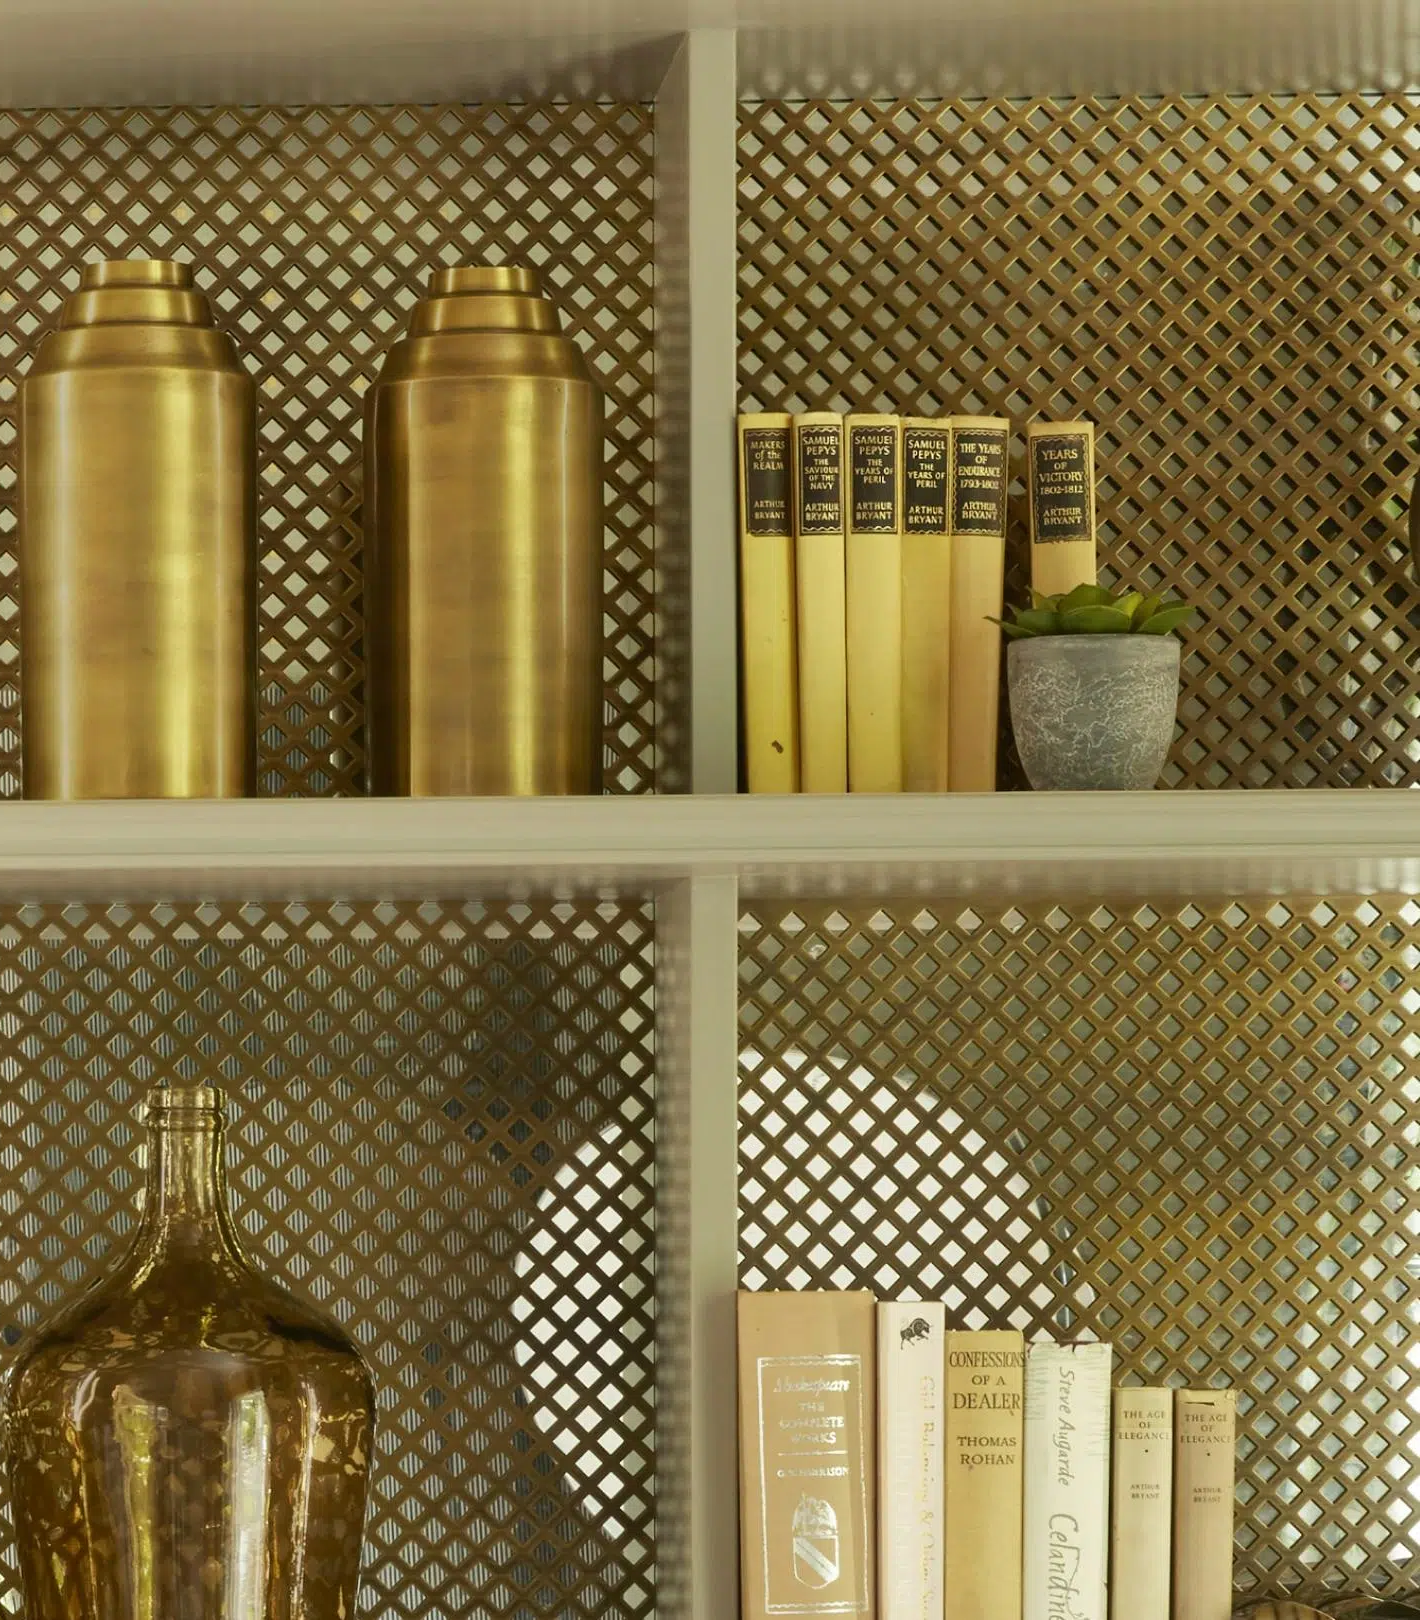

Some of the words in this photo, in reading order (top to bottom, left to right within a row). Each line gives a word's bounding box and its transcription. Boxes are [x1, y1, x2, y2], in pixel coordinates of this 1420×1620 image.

[750, 441, 785, 449] MAKERS
[803, 436, 839, 445] SAMUEL
[854, 436, 893, 445] SAMUEL
[908, 439, 946, 450] SAMUEL
[806, 446, 836, 456] PEPYS
[860, 446, 890, 455] PEPYS
[960, 444, 977, 454] THE
[978, 443, 1001, 454] YEARS
[755, 451, 763, 461] of
[768, 451, 781, 459] the
[912, 450, 941, 460] PEPYS
[1042, 449, 1078, 460] YEARS
[975, 455, 988, 464] OF
[753, 462, 784, 470] REALM
[805, 466, 839, 474] SAVIOUR
[919, 463, 934, 471] THE
[1054, 462, 1067, 470] OF
[855, 467, 881, 475] YEARS
[883, 467, 893, 475] OF
[908, 471, 933, 479] YEARS
[935, 471, 946, 479] OF
[958, 466, 1000, 477] ENDURANCE
[863, 476, 886, 484] PERIL
[1039, 471, 1083, 483] VICTORY
[916, 480, 937, 488] PERIL
[1040, 485, 1083, 495] 1802-1812
[805, 503, 839, 511] ARTHUR
[857, 502, 893, 510] ARTHUR
[909, 506, 944, 515] ARTHUR
[963, 501, 998, 511] ARTHUR
[805, 512, 839, 520] BRYANT
[856, 511, 892, 520] BRYANT
[962, 510, 997, 520] BRYANT
[1043, 507, 1082, 517] ARTHUR
[909, 515, 943, 524] BRYANT
[1044, 516, 1082, 525] BRYANT
[949, 1351, 1026, 1368] CONFESSIONS
[971, 1375, 990, 1385] OF
[996, 1375, 1007, 1385] A
[1059, 1366, 1075, 1414] Steve
[953, 1392, 1021, 1409] DEALER
[1123, 1410, 1143, 1419] THE
[1147, 1410, 1165, 1419] AGE
[1184, 1414, 1205, 1422] THE
[1209, 1414, 1227, 1422] AGE
[1139, 1421, 1151, 1429] OF
[1119, 1432, 1169, 1440] ELEGANCE
[956, 1436, 1017, 1447] THOMAS
[1052, 1417, 1076, 1487] Augarde
[960, 1453, 1015, 1465] ROHAN
